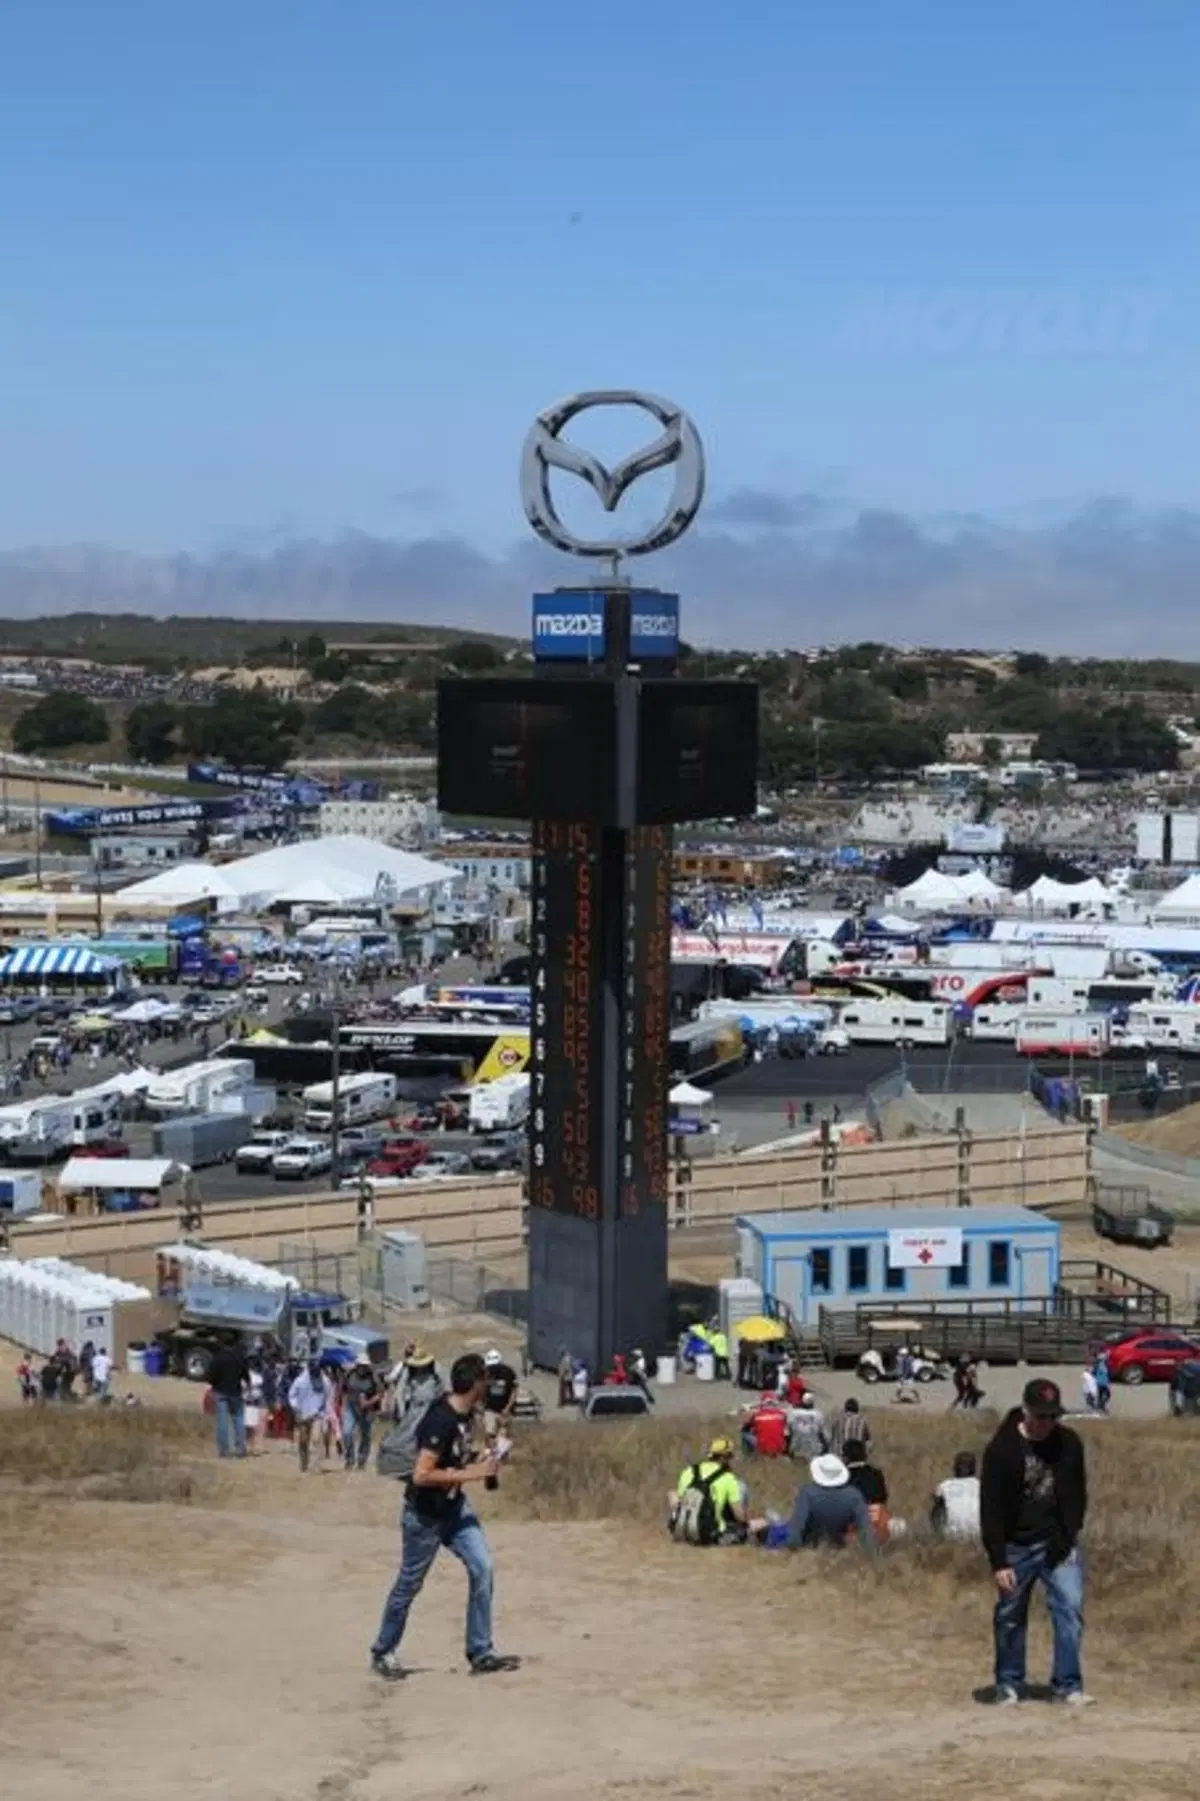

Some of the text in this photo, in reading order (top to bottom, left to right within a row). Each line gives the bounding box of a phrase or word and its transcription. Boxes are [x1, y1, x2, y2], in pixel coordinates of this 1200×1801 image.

[535, 614, 603, 636] mazda
[535, 967, 546, 992] 4
[535, 1002, 546, 1027] 5
[350, 1034, 416, 1046] DUNLOP
[535, 1071, 546, 1097] 7
